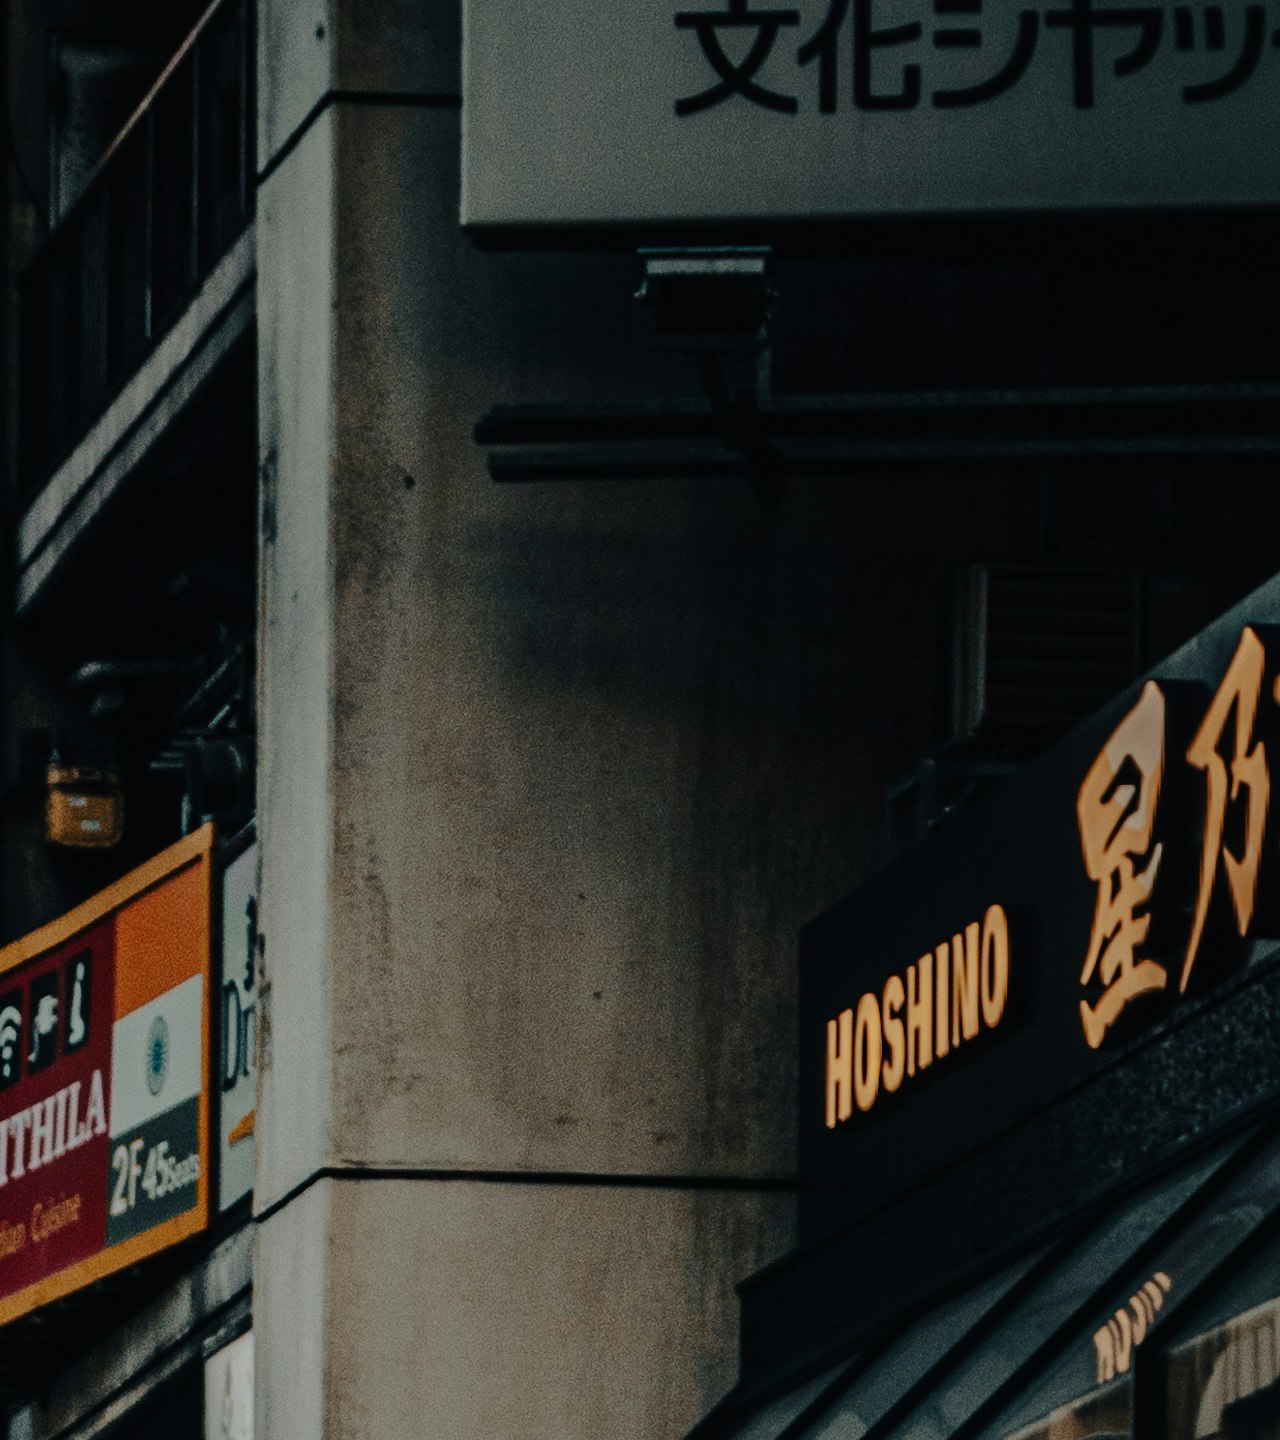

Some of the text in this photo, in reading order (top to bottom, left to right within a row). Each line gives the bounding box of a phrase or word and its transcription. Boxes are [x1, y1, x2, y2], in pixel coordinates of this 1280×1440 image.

[674, 0, 1280, 115] 文化シャッ
[1076, 626, 1280, 1050] 星乃
[825, 904, 1010, 1129] HOSHINO
[31, 1193, 82, 1242] Cuisine
[109, 1137, 145, 1217] 2F
